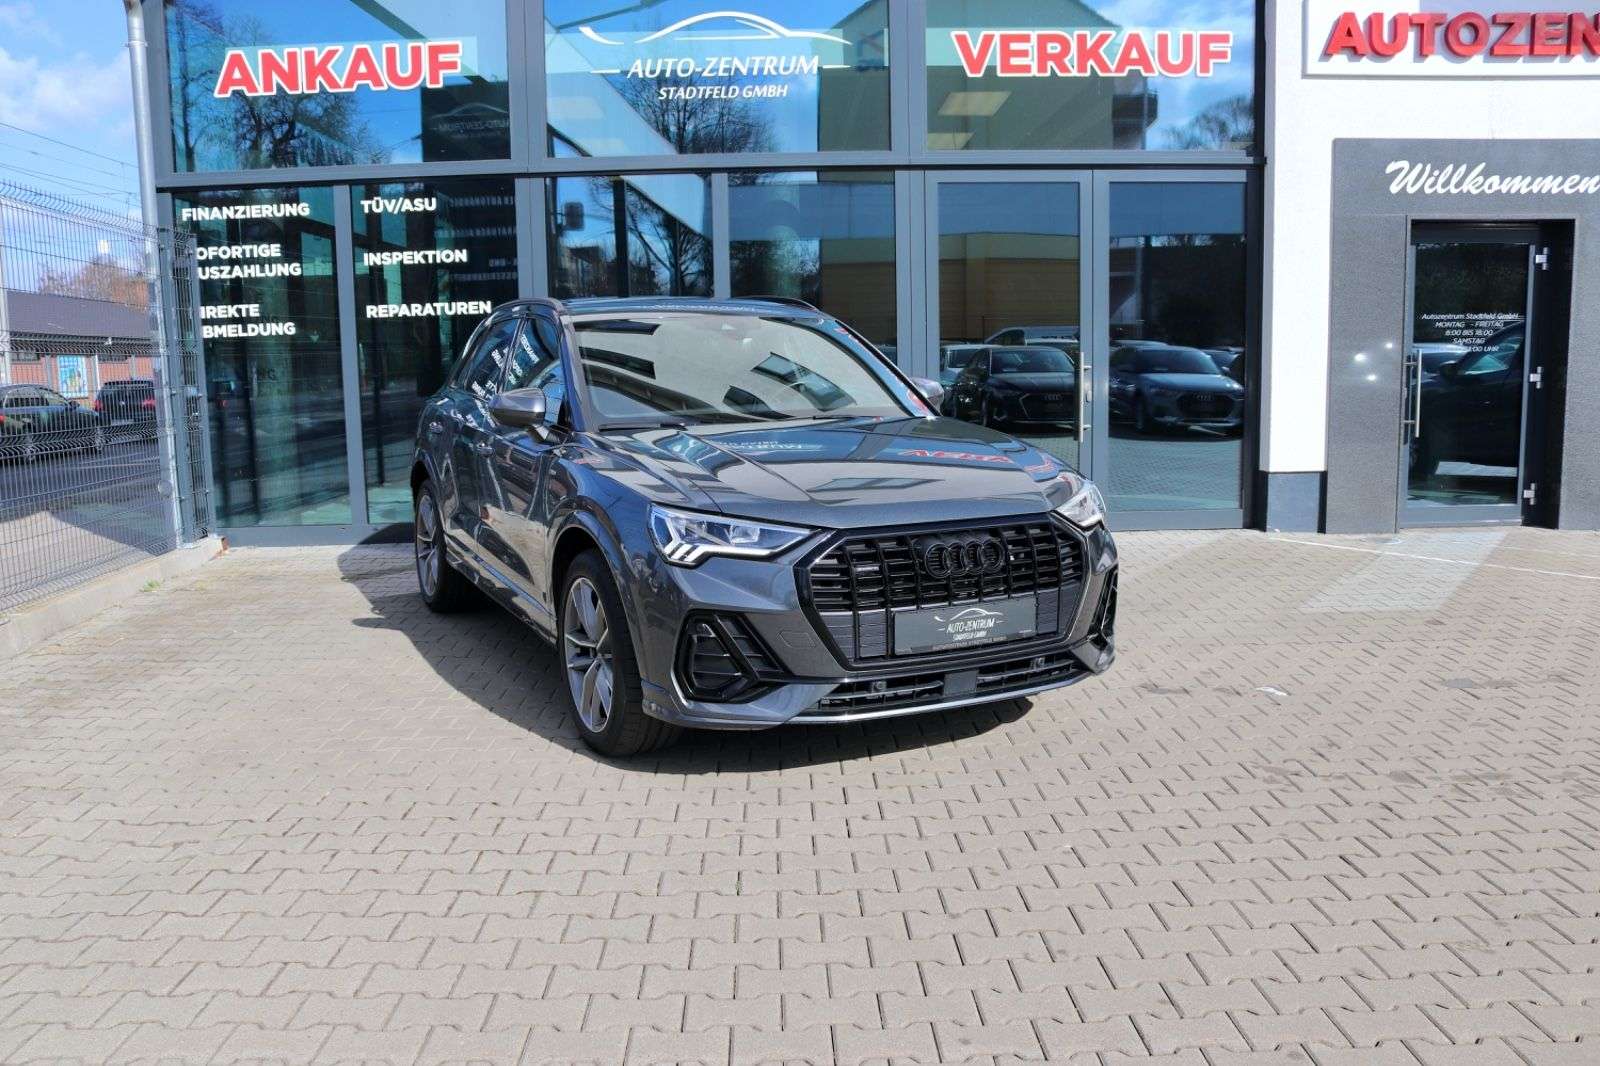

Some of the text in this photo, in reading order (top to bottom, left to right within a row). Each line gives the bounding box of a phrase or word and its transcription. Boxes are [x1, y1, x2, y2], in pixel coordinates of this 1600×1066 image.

[951, 31, 1232, 78] VERKAUF
[214, 40, 462, 98] ANKAUF
[627, 55, 819, 79] AUTO-ZENTRUM
[658, 84, 788, 100] STADTFELD GMBH
[1384, 160, 1600, 195] Willkommen
[181, 202, 311, 222] FINANZIERUNG
[360, 197, 437, 215] TÜV/ASU
[196, 243, 282, 261] OFORTIGE
[363, 248, 468, 267] INSPEKTION
[198, 262, 302, 281] USZAHLUNG
[200, 303, 260, 320] IREKTE
[366, 300, 492, 319] REPARATUREN
[202, 322, 297, 339] BMELDUNG
